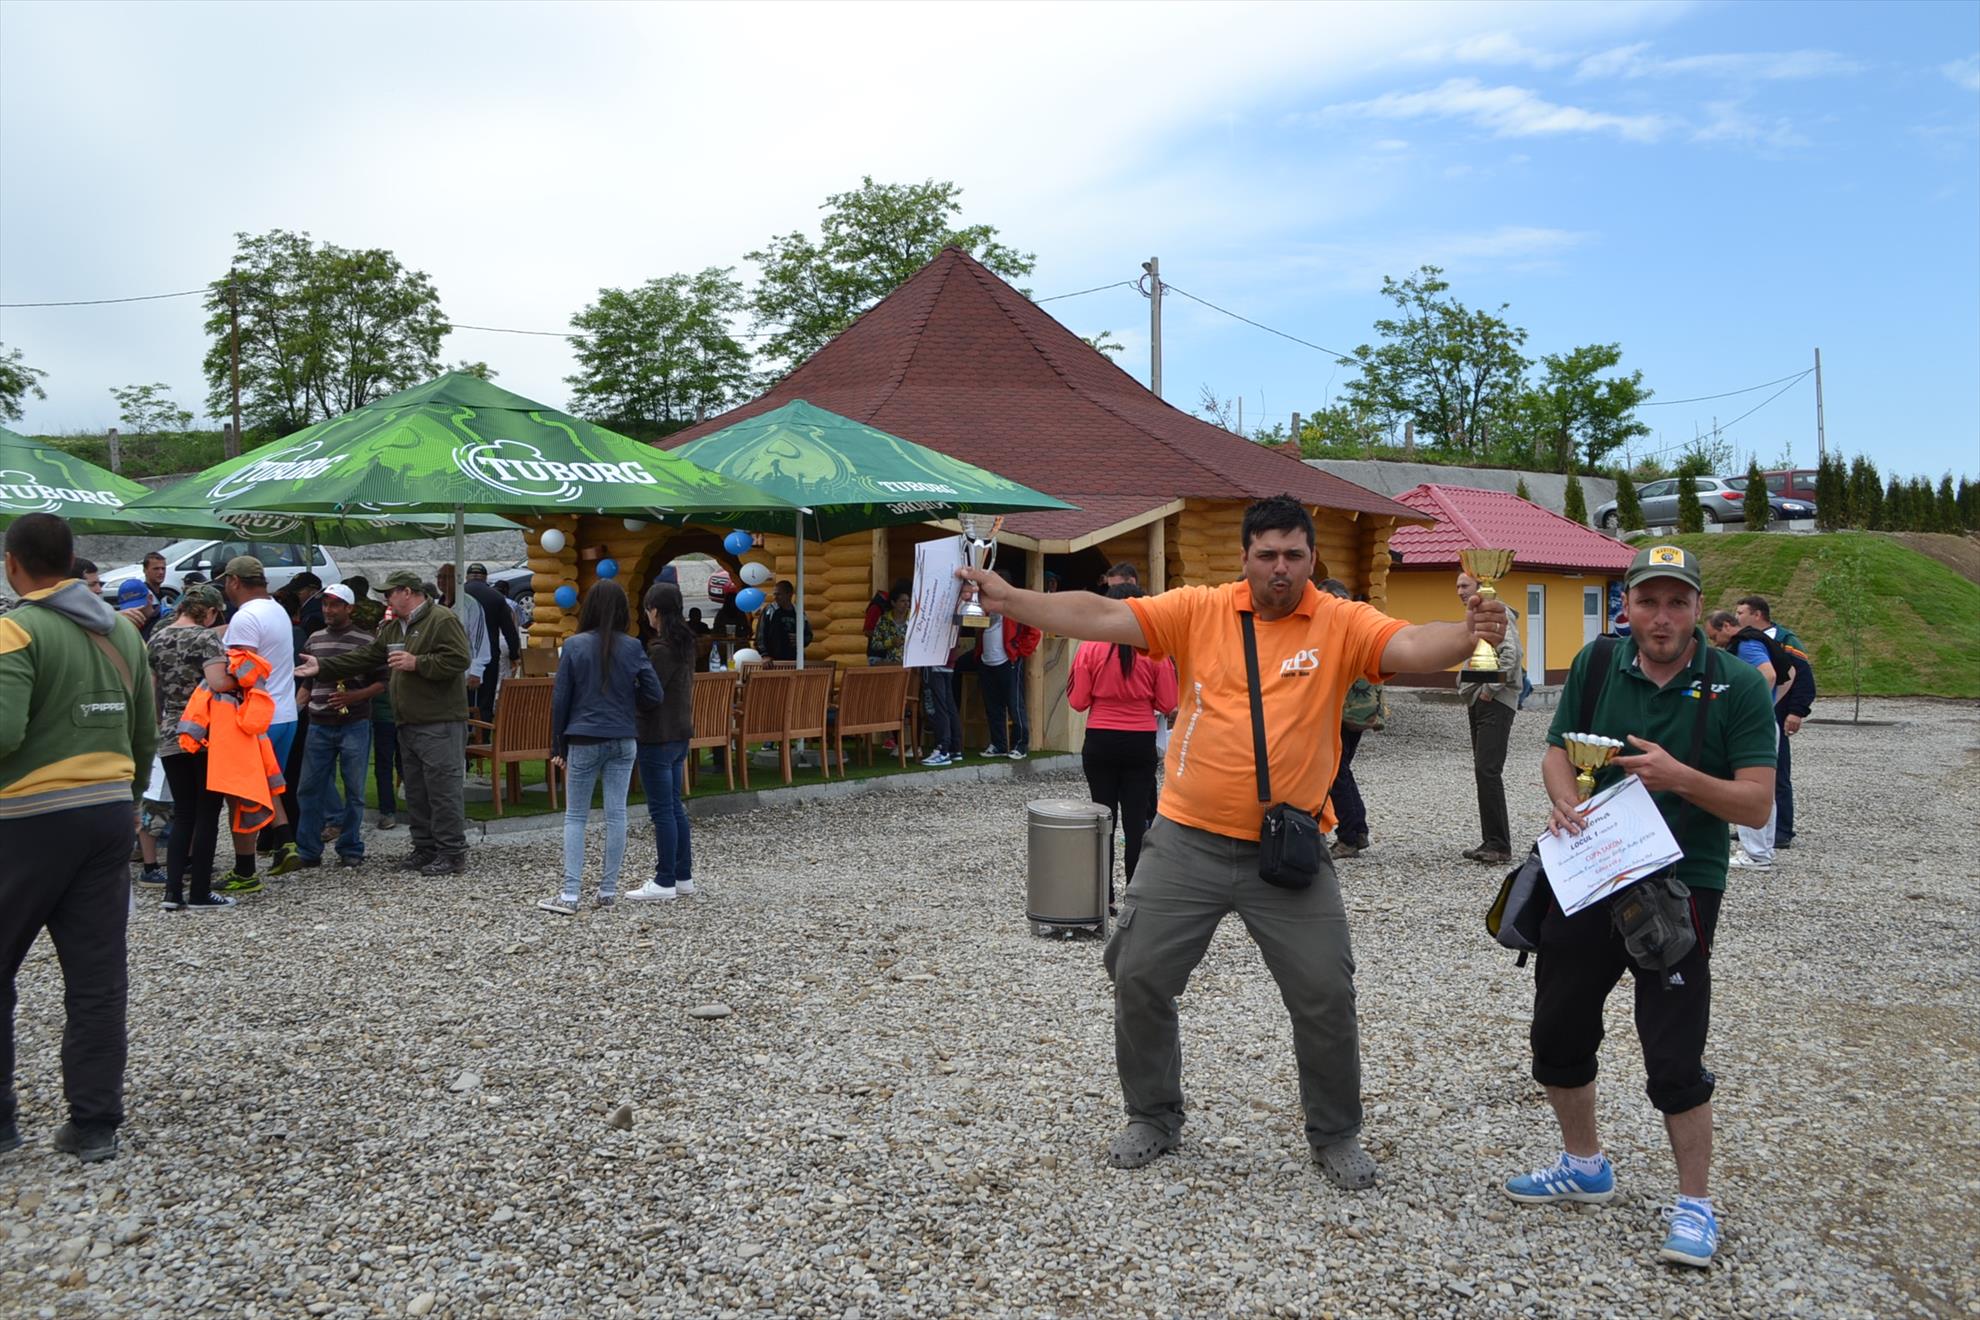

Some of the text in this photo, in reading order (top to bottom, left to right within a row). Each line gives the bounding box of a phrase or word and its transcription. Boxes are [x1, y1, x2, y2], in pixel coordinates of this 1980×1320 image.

[232, 454, 350, 483] TUBORG
[477, 456, 658, 485] TUBORG
[0, 484, 125, 507] TUBORG
[877, 481, 959, 495] TUBORG
[915, 588, 930, 633] Diploma
[1570, 834, 1594, 850] LOCUL
